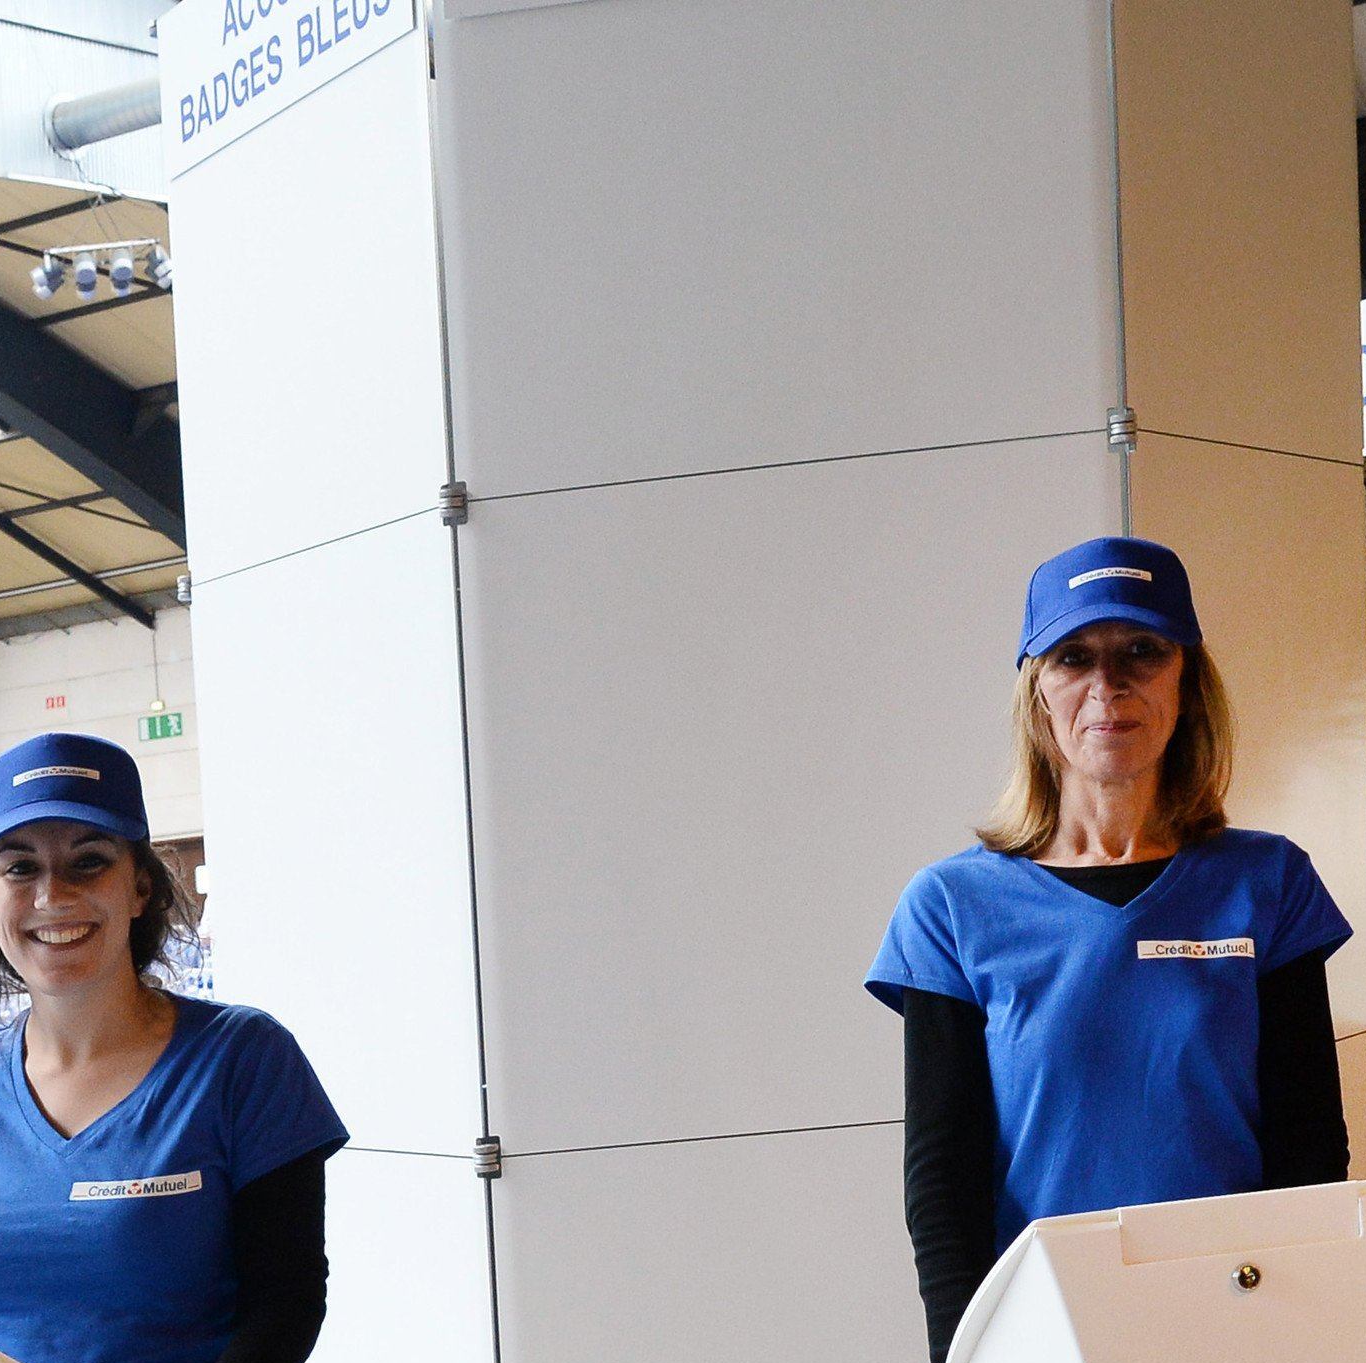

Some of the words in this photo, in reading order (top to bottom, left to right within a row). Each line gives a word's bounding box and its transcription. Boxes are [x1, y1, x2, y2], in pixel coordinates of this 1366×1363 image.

[180, 35, 282, 143] BADGES
[1207, 943, 1248, 955] Mutuel
[143, 1178, 187, 1194] Mutuel
